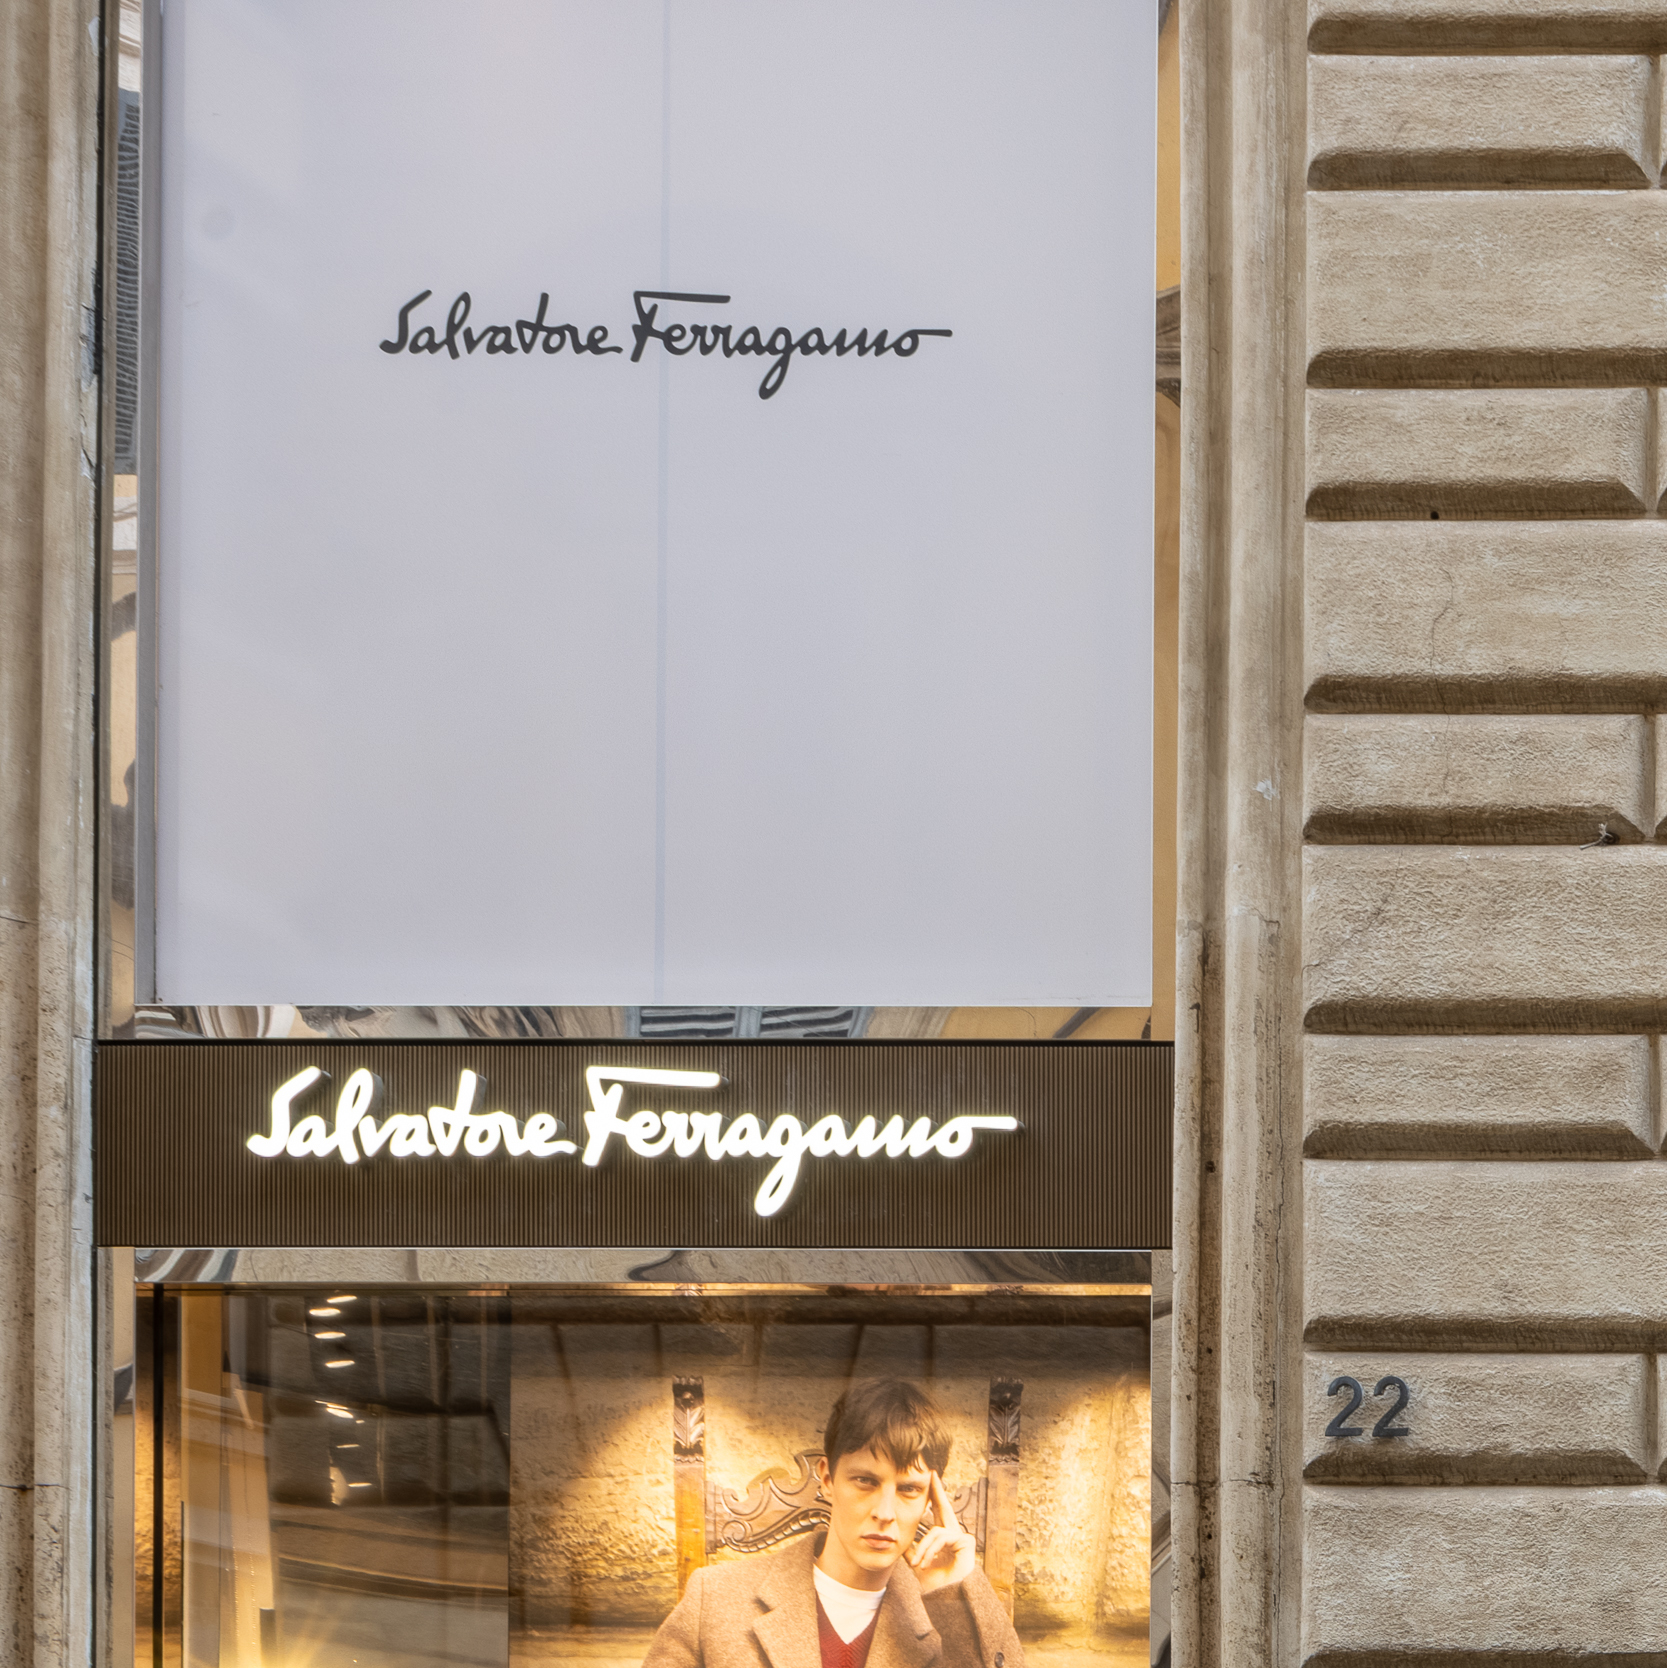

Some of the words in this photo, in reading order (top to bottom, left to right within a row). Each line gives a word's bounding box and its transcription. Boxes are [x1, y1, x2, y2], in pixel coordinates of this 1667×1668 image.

[380, 290, 622, 362] Salvatore
[630, 290, 954, 400] Ferragamo
[246, 1065, 578, 1164] Salvatore
[582, 1065, 1020, 1218] Ferragamo
[1325, 1375, 1410, 1437] 22
